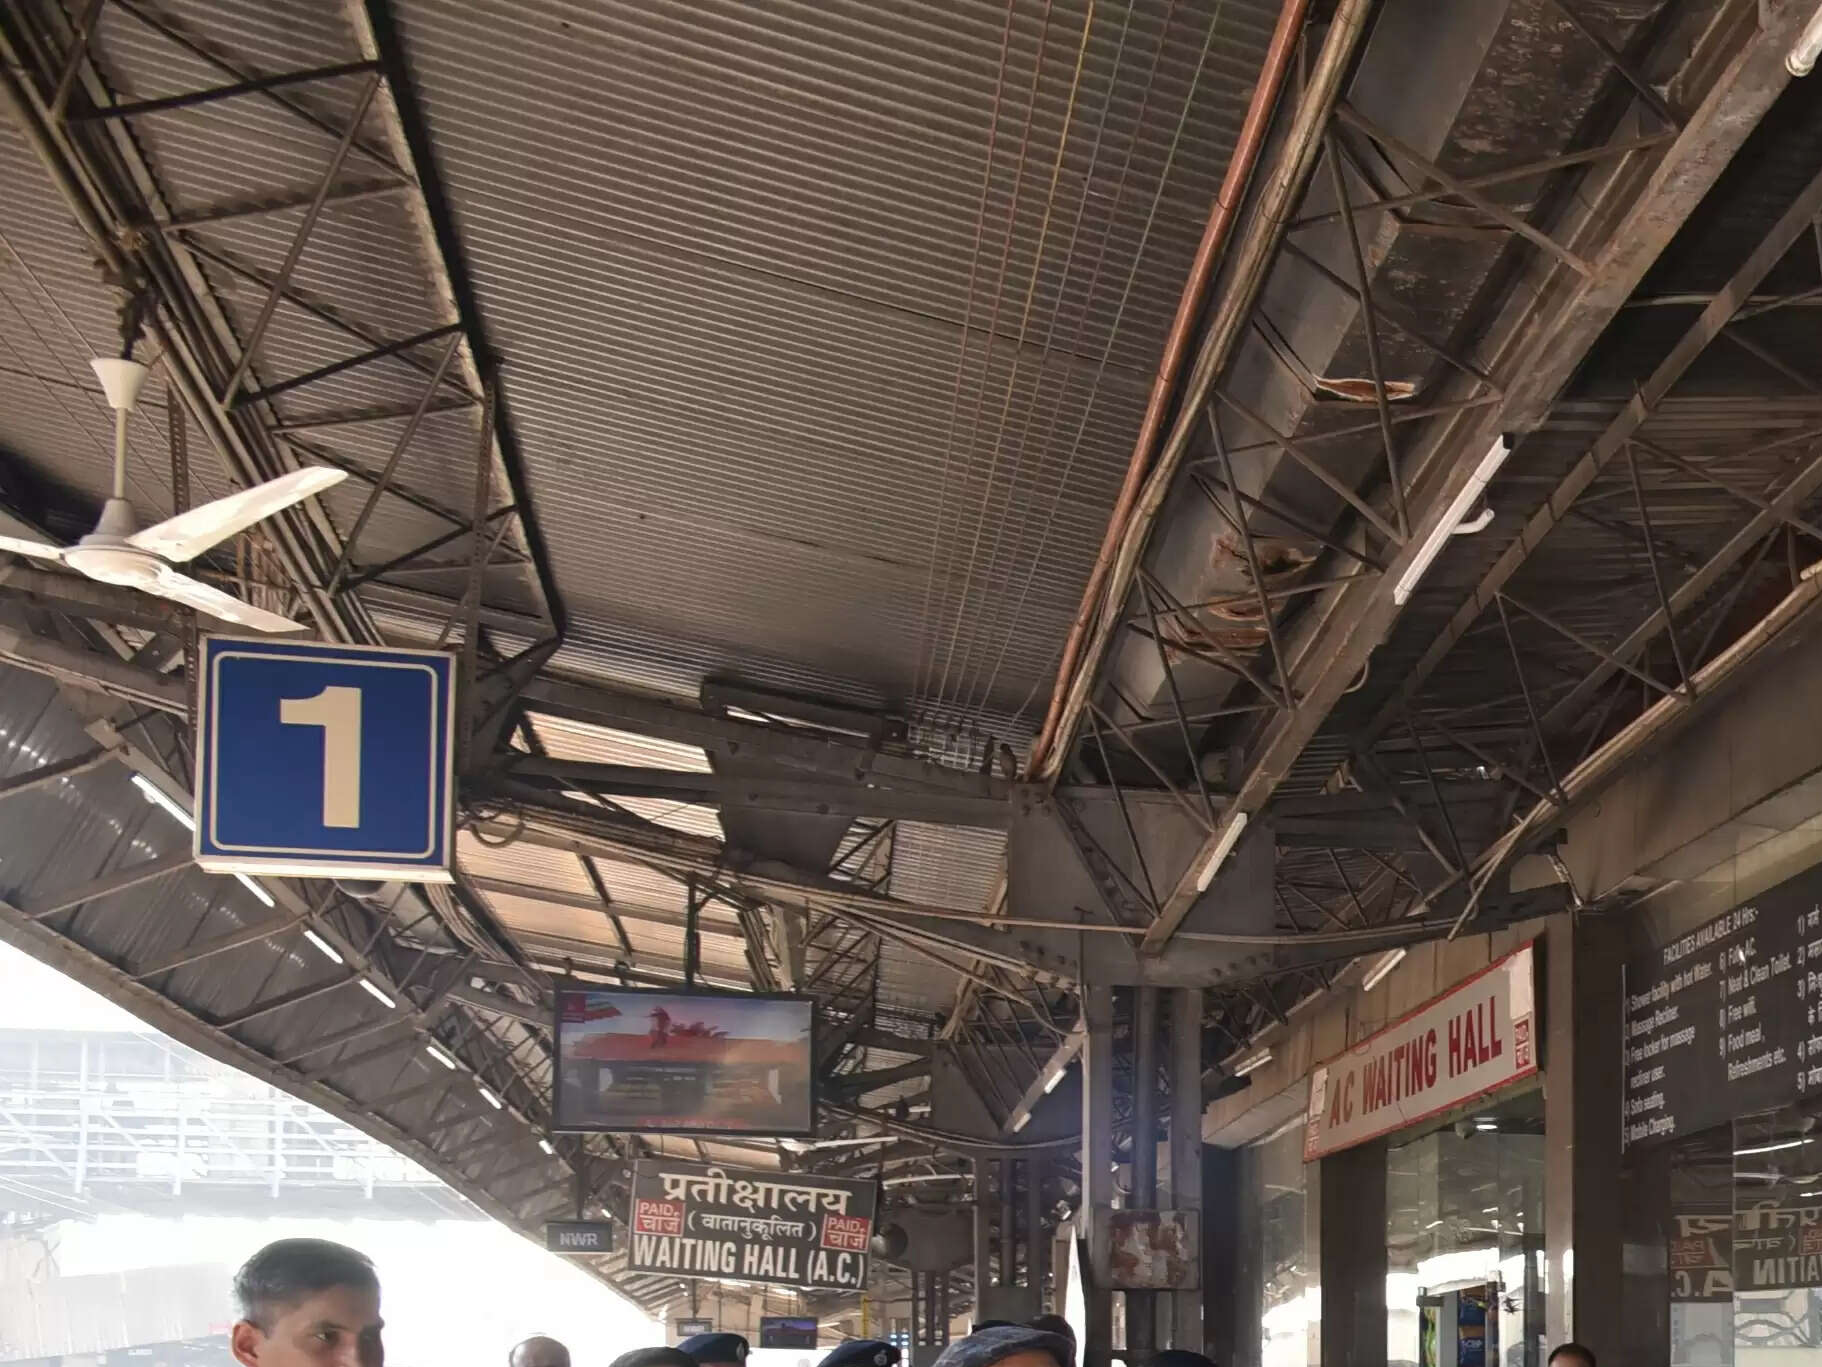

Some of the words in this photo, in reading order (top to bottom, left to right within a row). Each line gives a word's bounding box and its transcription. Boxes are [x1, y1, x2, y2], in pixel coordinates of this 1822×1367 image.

[280, 686, 363, 829] 1
[1363, 1027, 1437, 1115] WAITING
[1448, 995, 1502, 1078] HALL
[640, 1202, 673, 1217] PAID
[659, 1167, 853, 1216] प्रतीक्षालय
[559, 1232, 599, 1247] NWR
[828, 1218, 860, 1233] PAID
[633, 1235, 736, 1274] WAITING
[743, 1243, 799, 1279] HALL
[806, 1248, 865, 1287] (A.C.)
